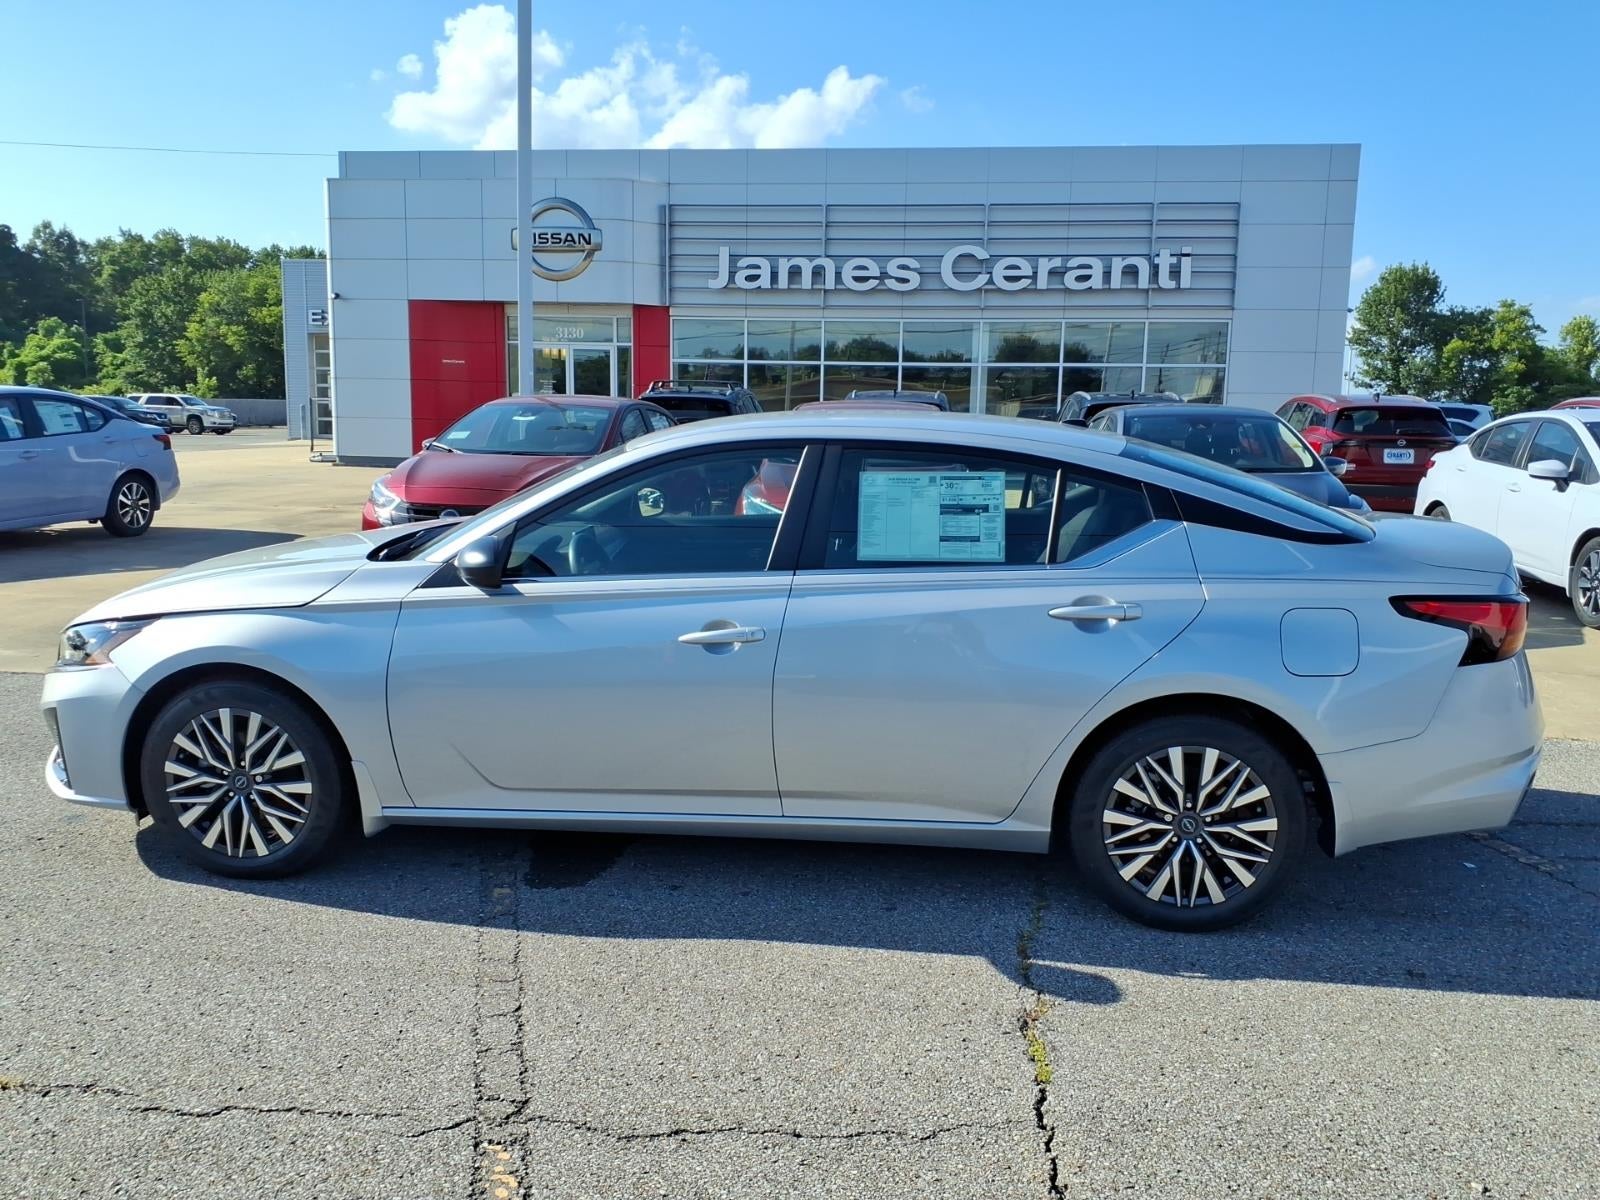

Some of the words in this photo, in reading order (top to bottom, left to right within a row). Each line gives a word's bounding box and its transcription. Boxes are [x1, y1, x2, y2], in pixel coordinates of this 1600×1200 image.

[530, 232, 592, 245] ISSAN
[708, 246, 921, 291] James
[940, 244, 1192, 291] Ceranti
[555, 326, 584, 338] 3130
